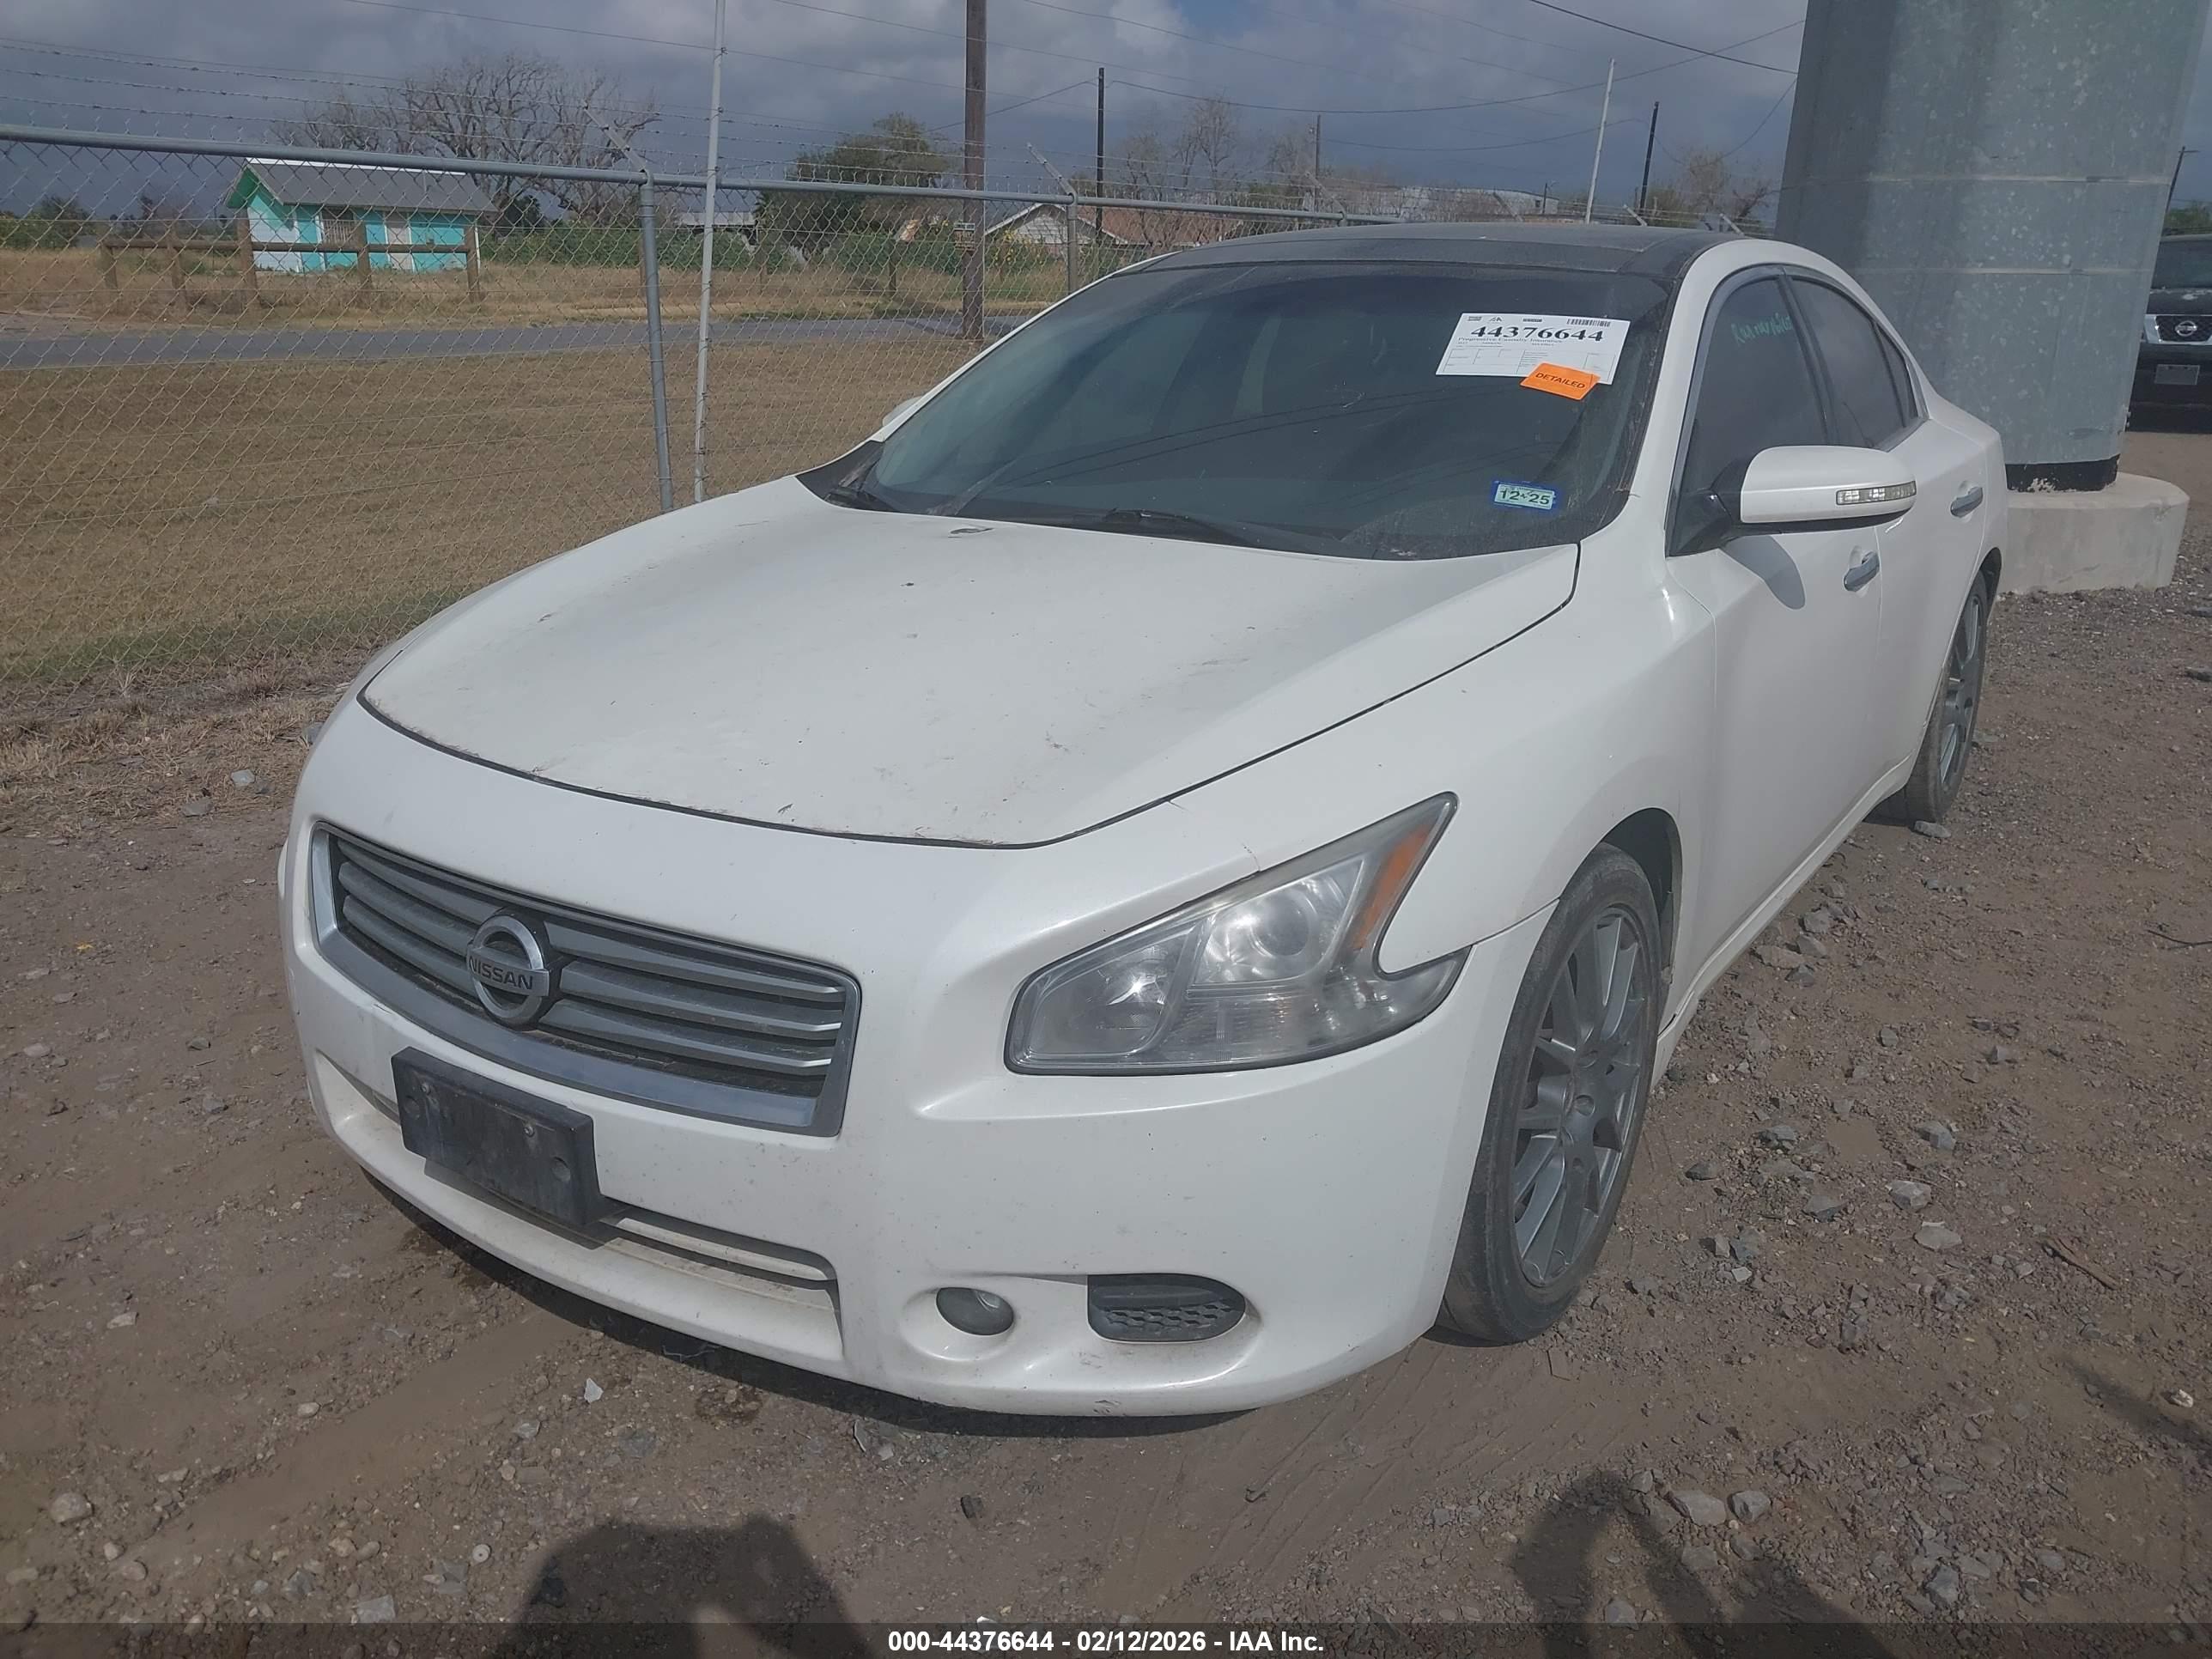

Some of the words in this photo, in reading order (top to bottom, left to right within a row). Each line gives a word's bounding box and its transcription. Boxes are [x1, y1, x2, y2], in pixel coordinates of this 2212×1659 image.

[1471, 326, 1603, 342] 44376644
[1535, 373, 1585, 388] DETAILED
[469, 956, 532, 990] NISSAN
